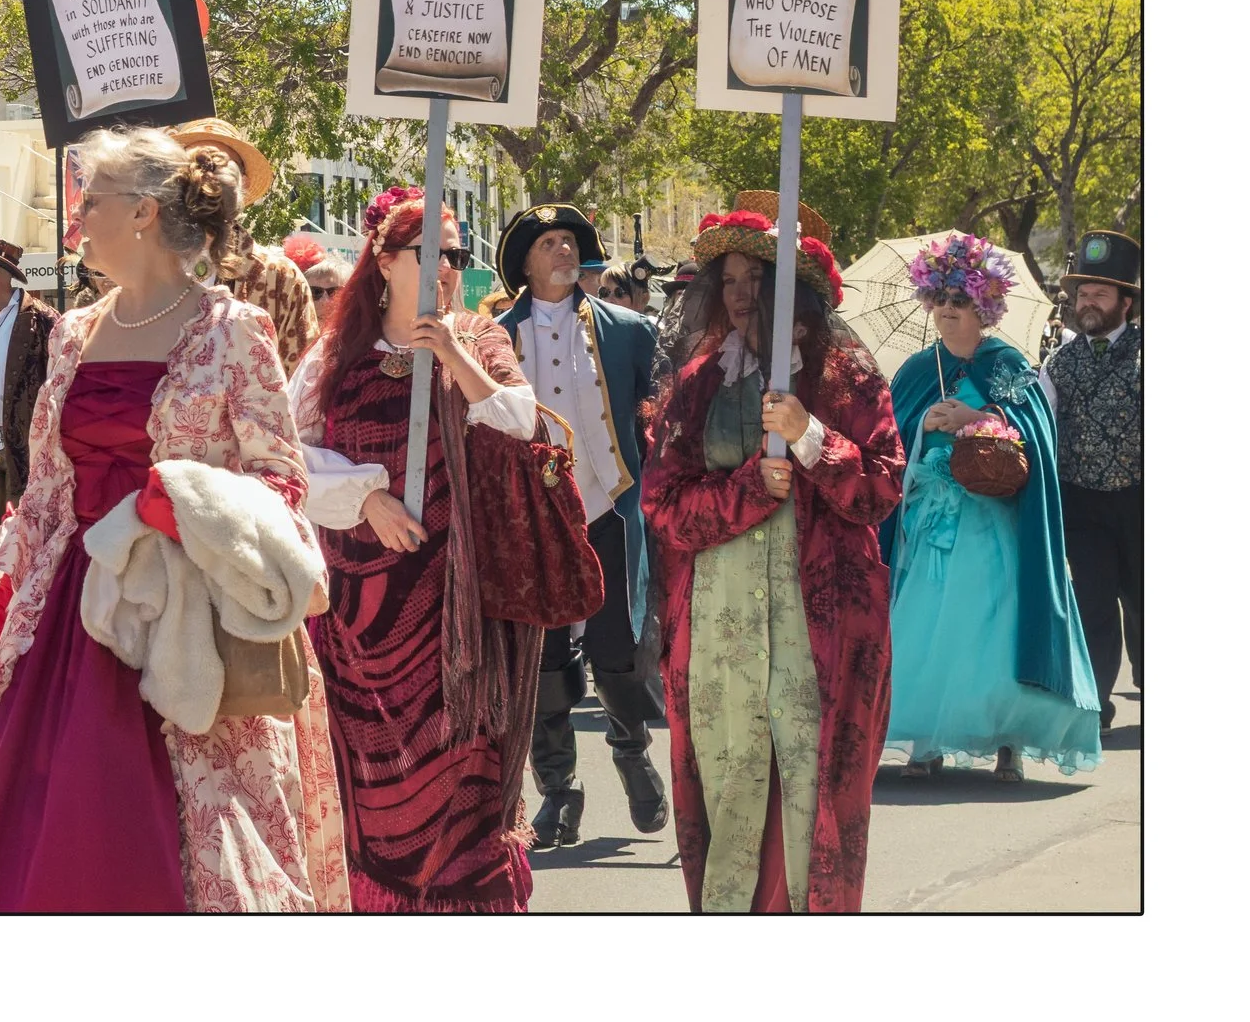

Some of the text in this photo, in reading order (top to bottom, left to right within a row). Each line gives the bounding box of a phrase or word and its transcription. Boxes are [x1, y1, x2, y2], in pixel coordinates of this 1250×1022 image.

[65, 9, 77, 22] in
[421, 0, 485, 21] JUSTICE
[71, 12, 155, 42] with those who are
[408, 28, 492, 45] CEASEFIRE NOW
[746, 18, 842, 50] THE VIOLENCE
[86, 29, 158, 59] SUFFERING
[398, 45, 483, 65] END GENOCIDE
[86, 54, 160, 80] END GENOCIDE
[767, 47, 831, 76] OF MEN
[100, 72, 164, 95] #CEASEFIRE
